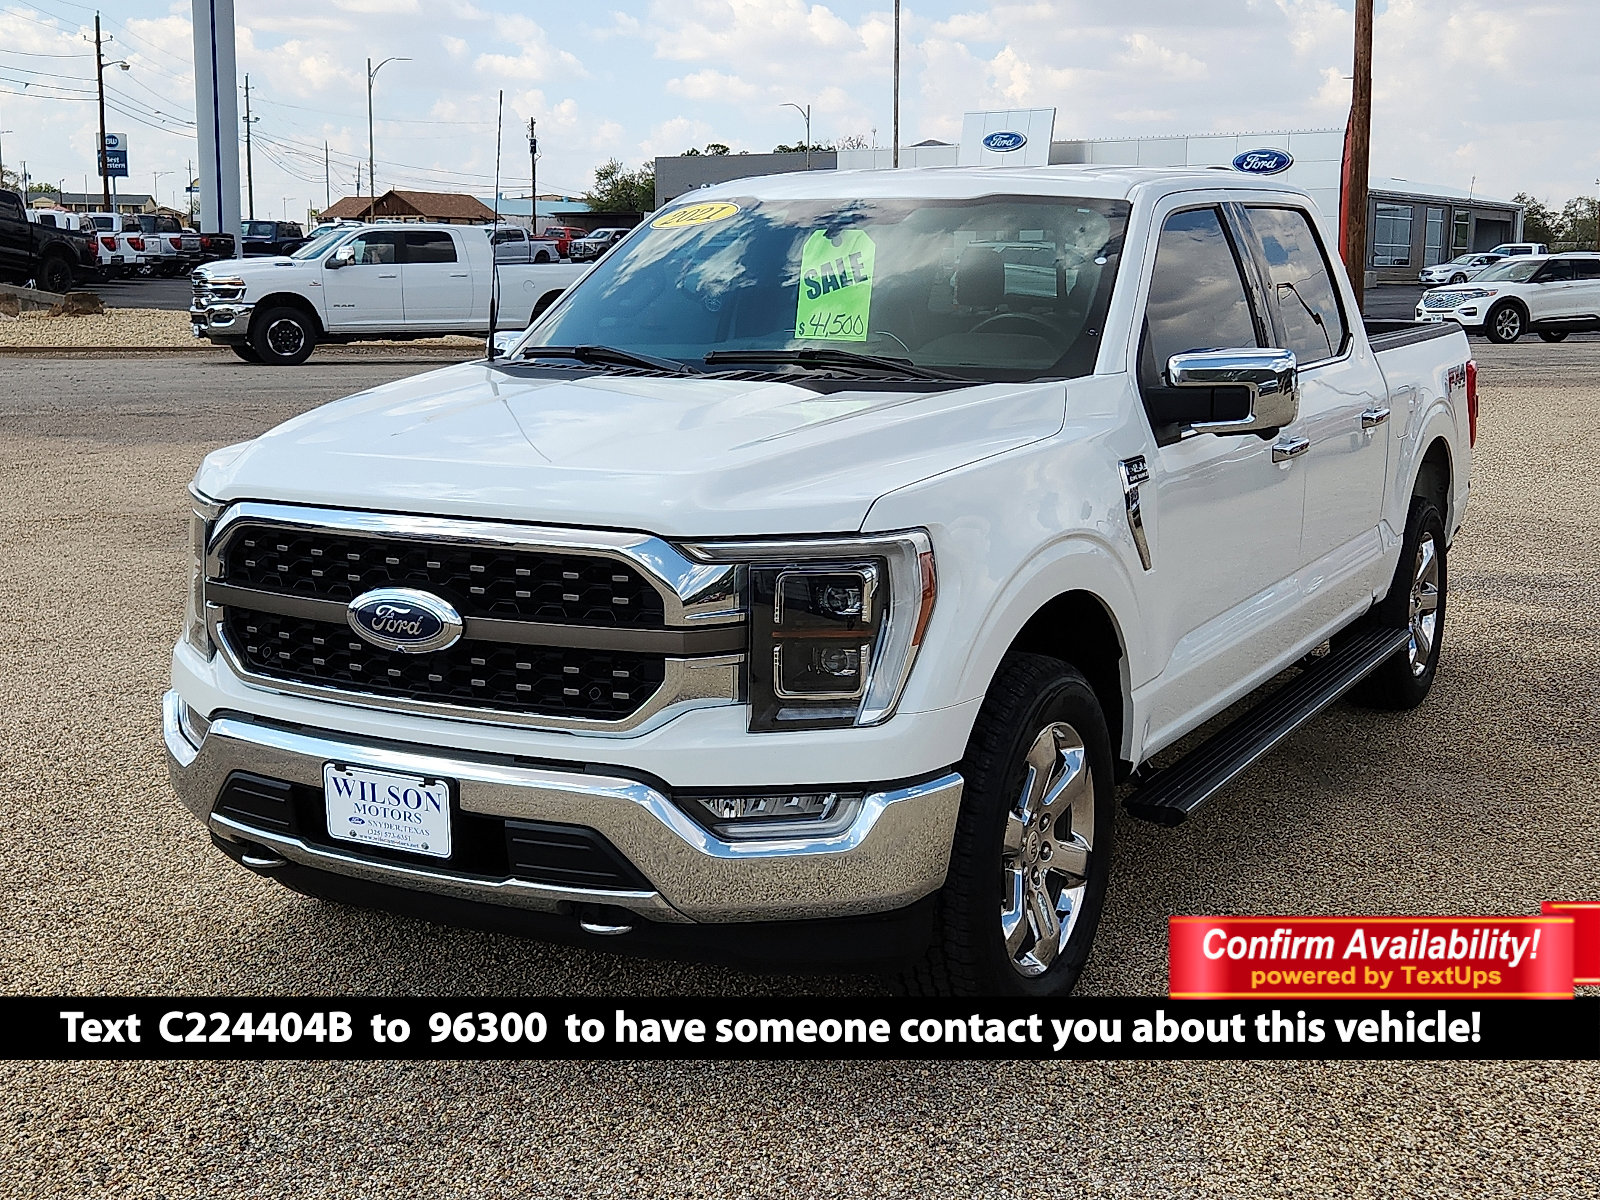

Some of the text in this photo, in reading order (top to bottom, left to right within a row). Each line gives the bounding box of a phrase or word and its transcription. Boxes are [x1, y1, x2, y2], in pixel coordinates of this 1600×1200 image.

[988, 134, 1014, 147] Ford
[1242, 153, 1277, 170] Ford
[660, 205, 730, 226] 2021
[804, 251, 868, 300] SALE
[799, 313, 864, 338] $ 41,500
[371, 604, 424, 635] Ford
[332, 777, 442, 813] WILSON
[353, 803, 422, 824] MOTORS
